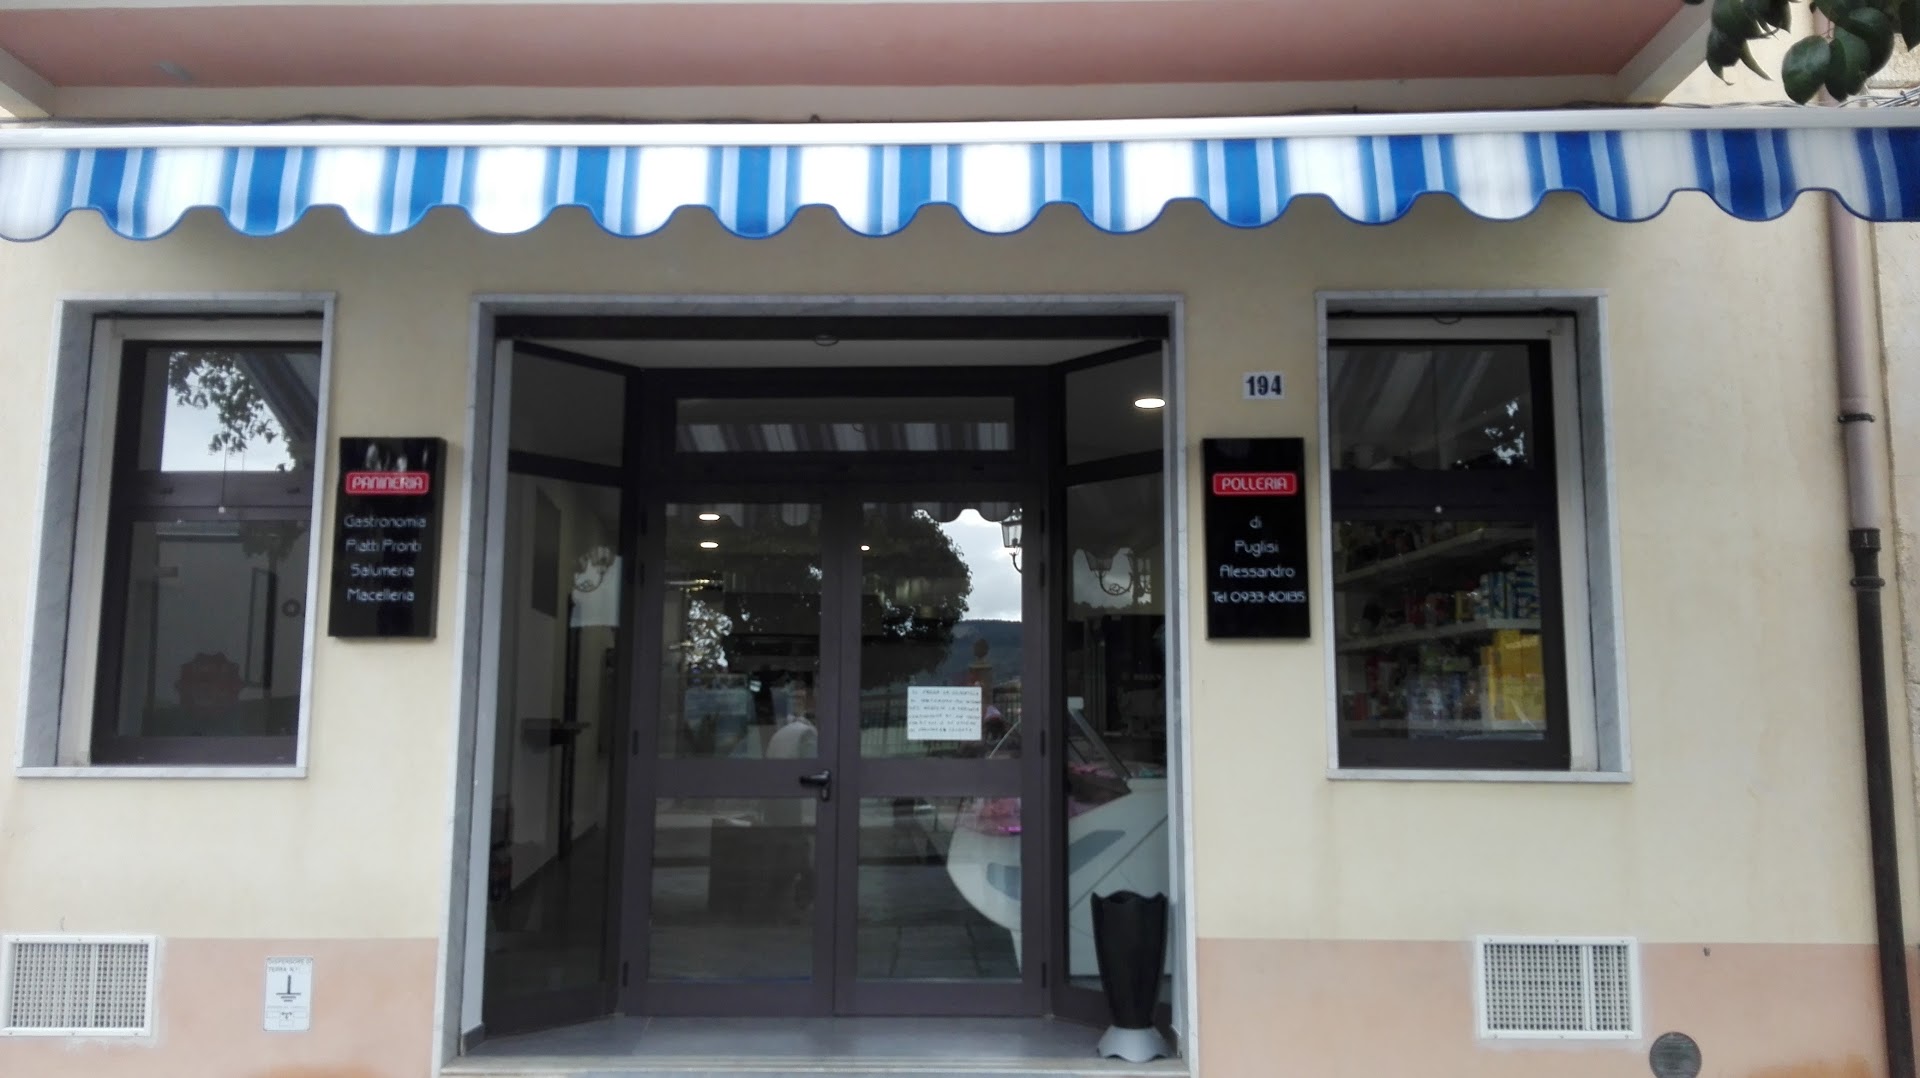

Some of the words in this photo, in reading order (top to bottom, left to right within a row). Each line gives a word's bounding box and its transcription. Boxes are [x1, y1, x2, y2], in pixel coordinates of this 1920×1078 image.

[1245, 375, 1282, 396] 194
[352, 476, 423, 490] PANINERIA
[1221, 477, 1288, 491] POLLERIA
[344, 515, 426, 528] Gastronomia
[1249, 515, 1262, 529] di
[346, 539, 378, 552] Piatti
[382, 539, 422, 552] Pronti
[1235, 540, 1279, 557] Puglisi
[350, 563, 415, 577] Salumeria
[1219, 564, 1296, 578] Alessandro
[347, 588, 415, 602] Macelleria
